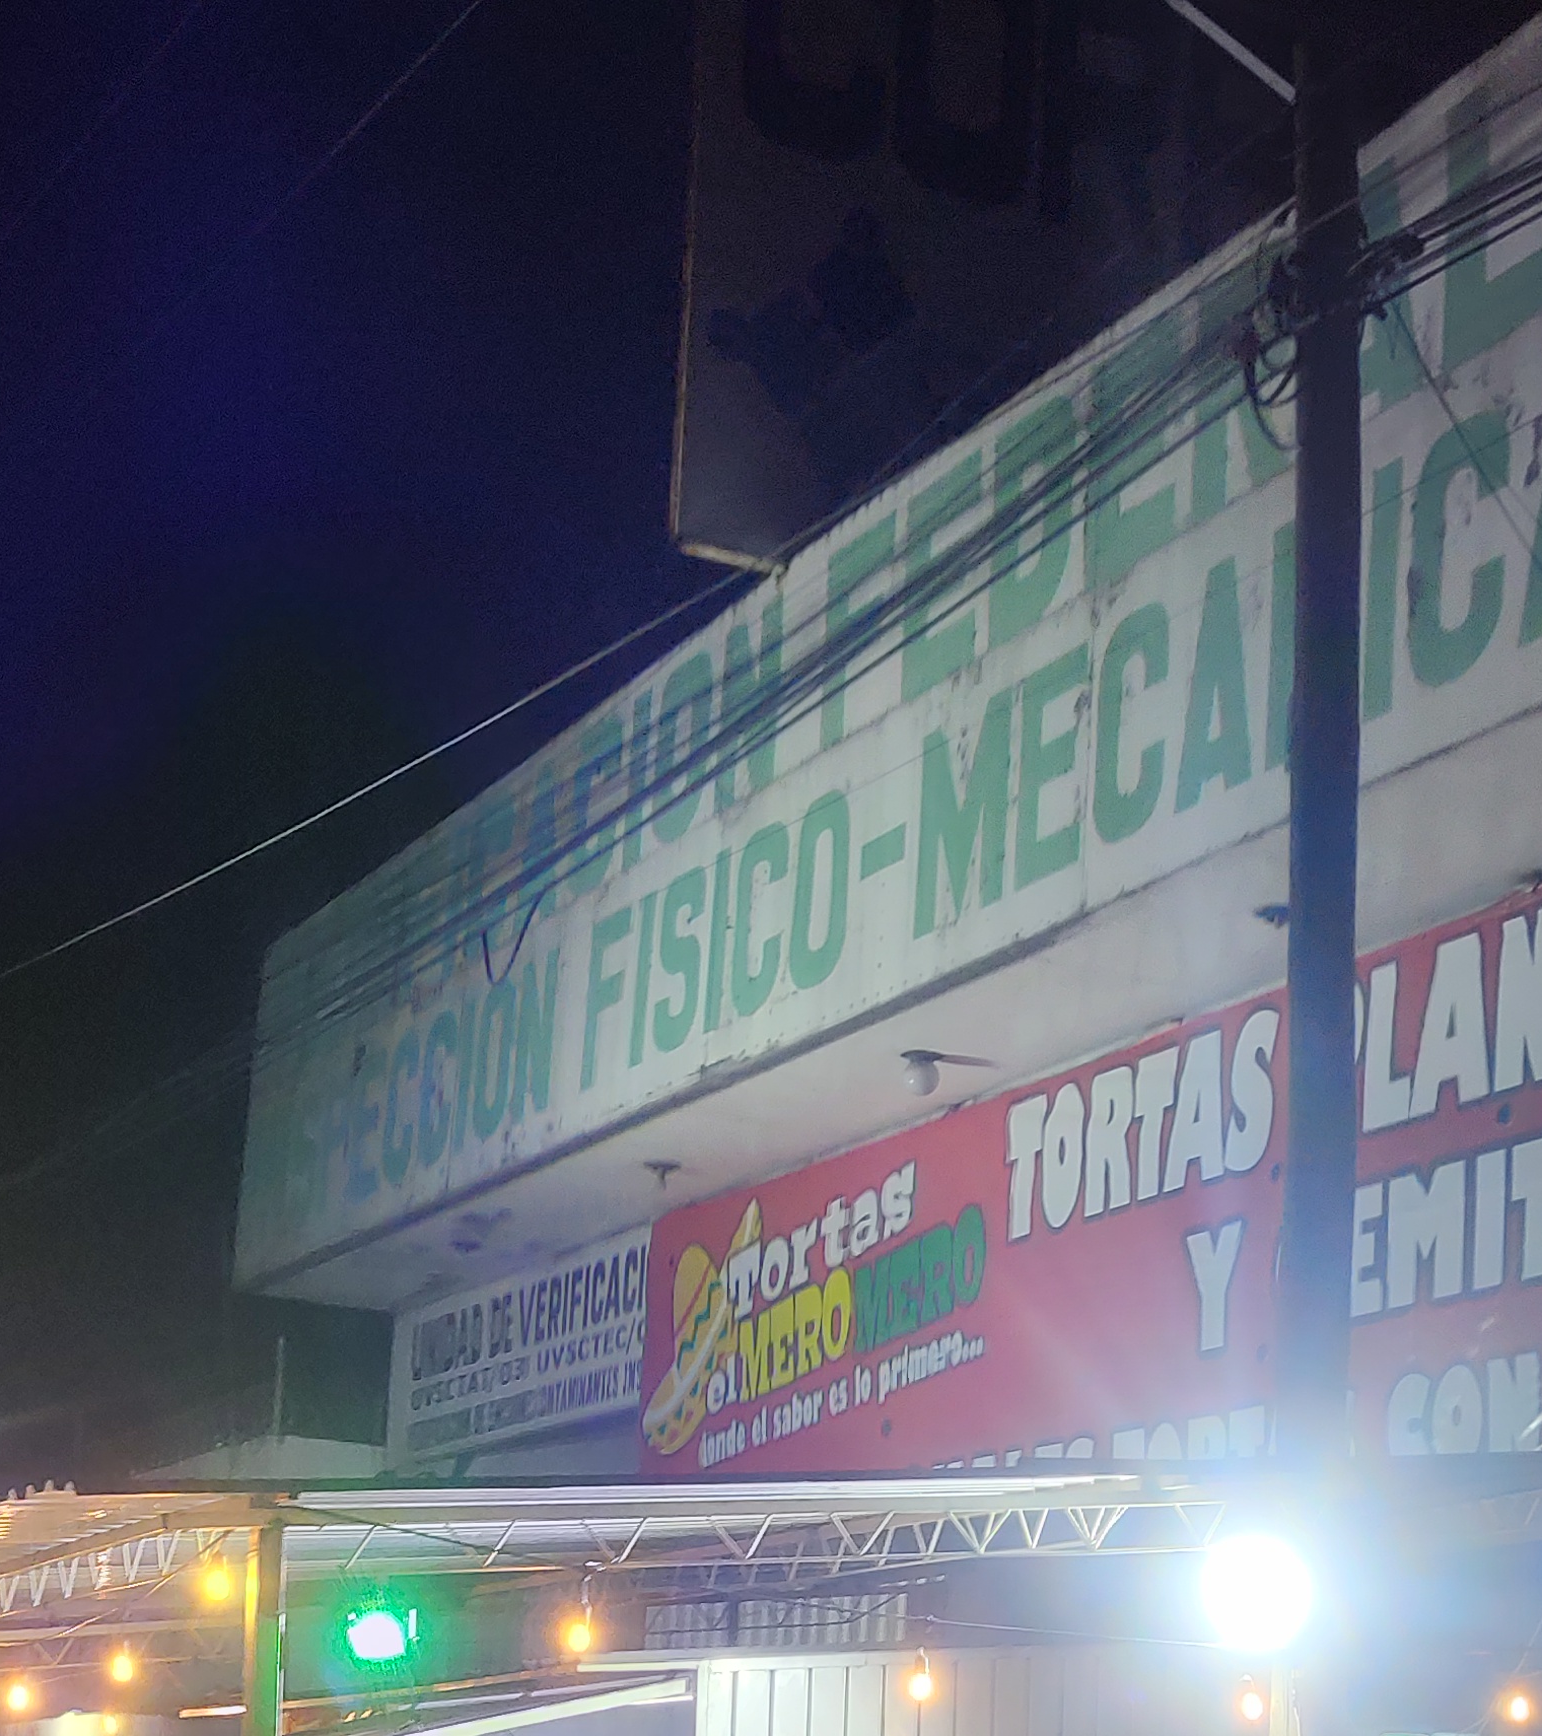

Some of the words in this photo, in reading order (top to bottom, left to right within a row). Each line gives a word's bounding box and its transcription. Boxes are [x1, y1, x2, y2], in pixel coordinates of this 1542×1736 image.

[1007, 1008, 1281, 1240] TORTAS
[728, 1160, 916, 1322] Tortas
[1185, 1220, 1244, 1353] Y
[488, 1293, 513, 1359] DE
[706, 1352, 742, 1416] el
[739, 1266, 852, 1402] MERO
[854, 1203, 987, 1354] MERO
[751, 1409, 769, 1447] el
[772, 1388, 825, 1441] sabor
[828, 1377, 848, 1417] es
[853, 1363, 872, 1407] lo
[1389, 1352, 1540, 1456] CON
